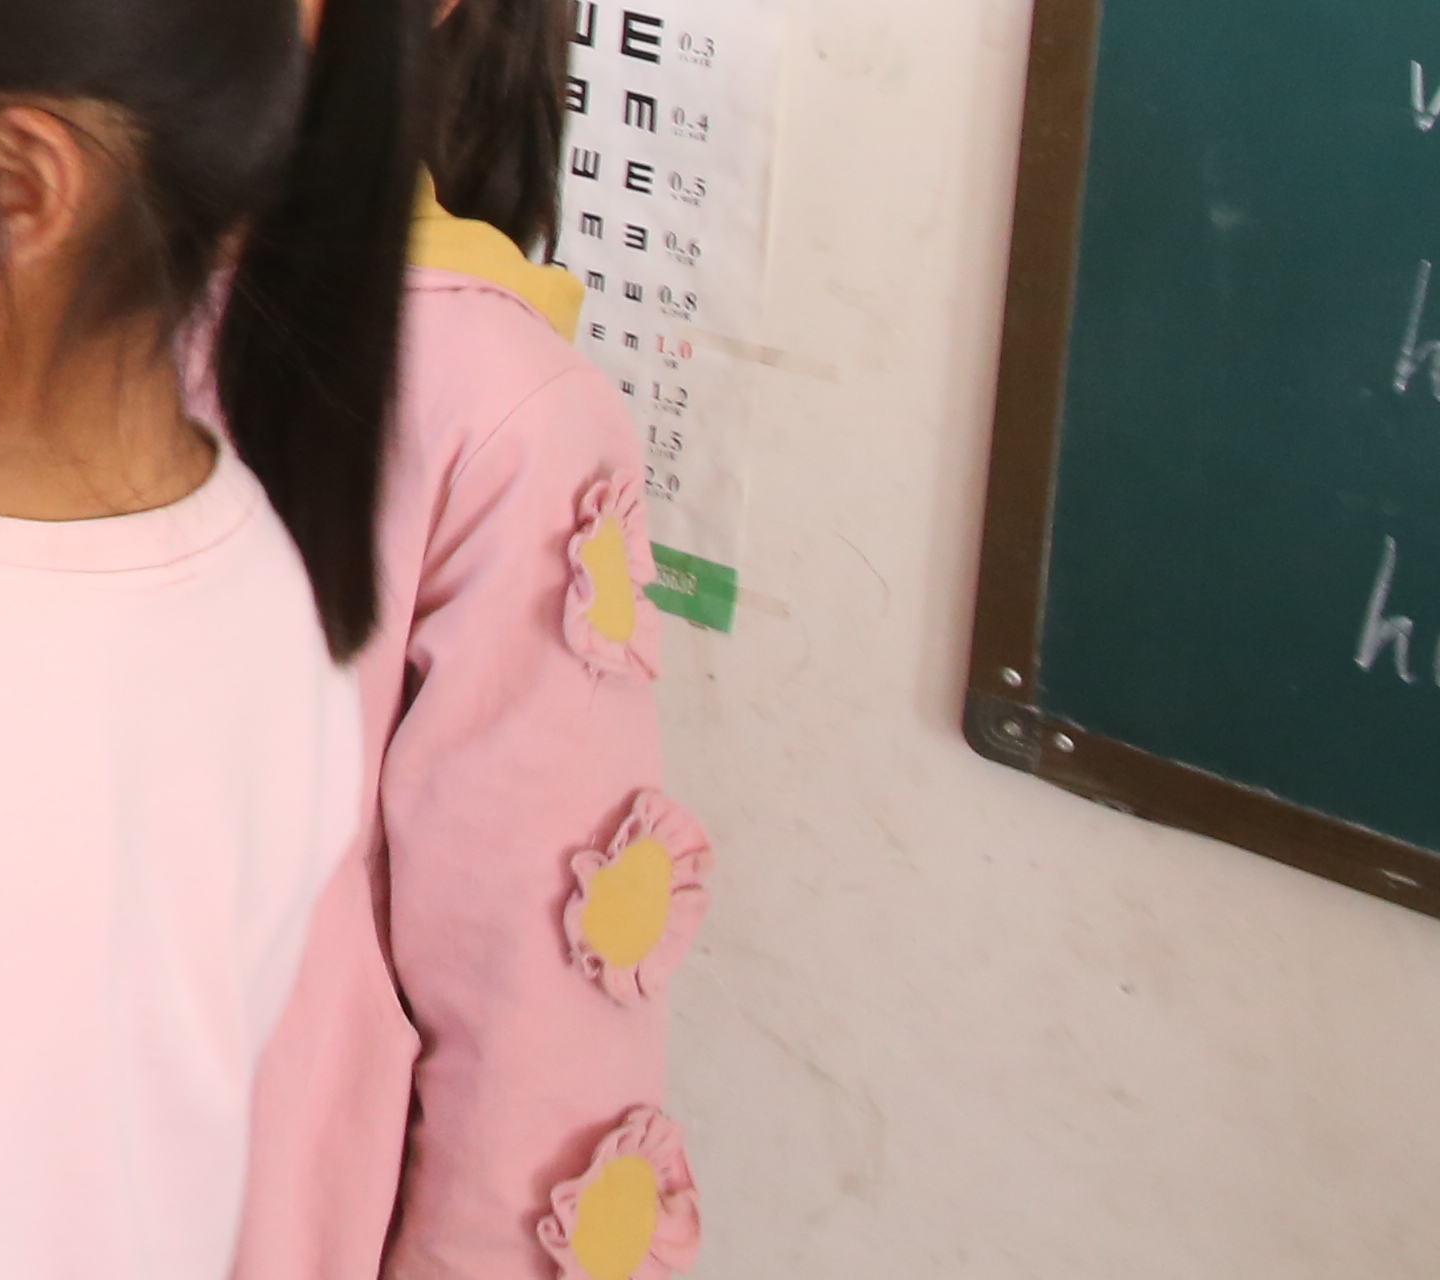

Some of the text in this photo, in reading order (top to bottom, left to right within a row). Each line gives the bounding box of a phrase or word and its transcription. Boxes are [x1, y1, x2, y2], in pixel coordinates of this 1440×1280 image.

[678, 32, 716, 59] 0.3
[672, 106, 711, 134] 0.4
[668, 171, 708, 200] 0.5
[664, 230, 703, 258] 0.6
[657, 285, 699, 313] 0.8
[655, 333, 693, 360] 1.0
[651, 380, 689, 409] 1.2
[646, 425, 684, 453] 1.5
[644, 464, 681, 492] 2.0
[1352, 534, 1440, 686] h
